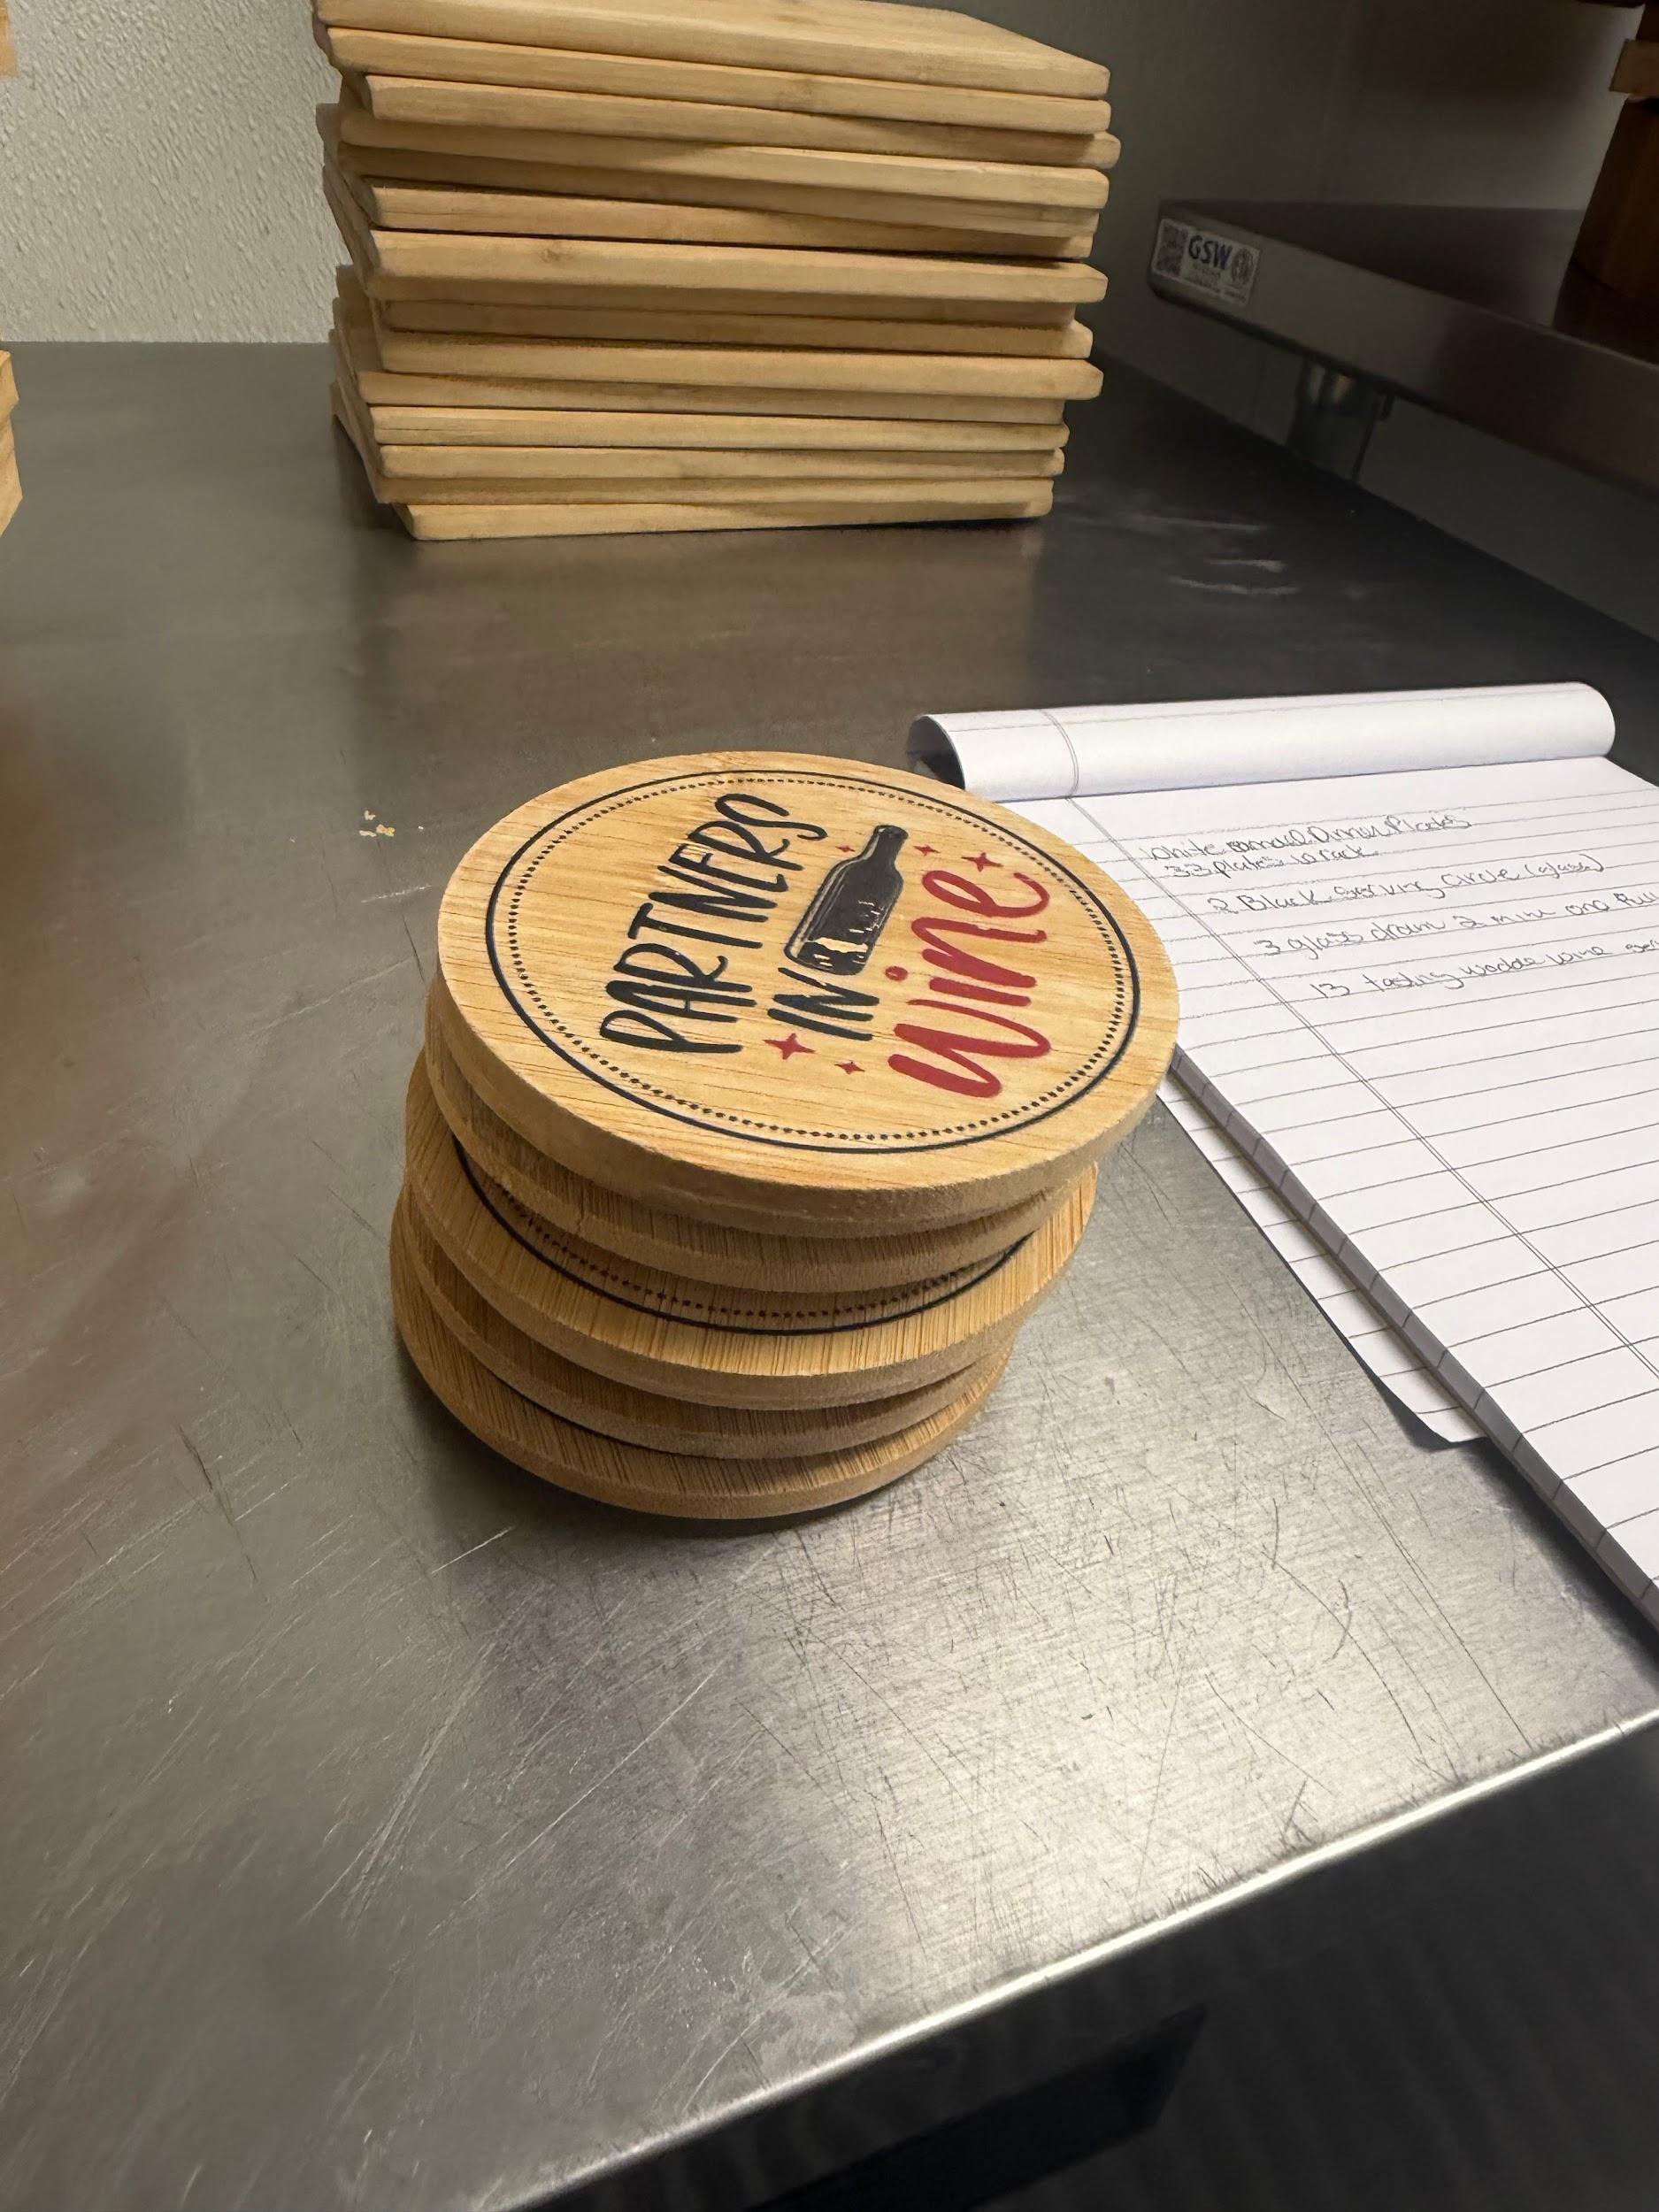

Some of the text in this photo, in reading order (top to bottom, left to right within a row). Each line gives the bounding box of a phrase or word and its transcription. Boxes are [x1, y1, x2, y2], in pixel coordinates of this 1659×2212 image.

[1188, 234, 1233, 270] GSW
[1237, 889, 1332, 910] Black
[599, 793, 829, 1054] PARTNERS
[1253, 939, 1281, 956] 3
[886, 869, 1052, 1098] wine
[1310, 983, 1351, 999] 13
[766, 966, 880, 1041] IN
